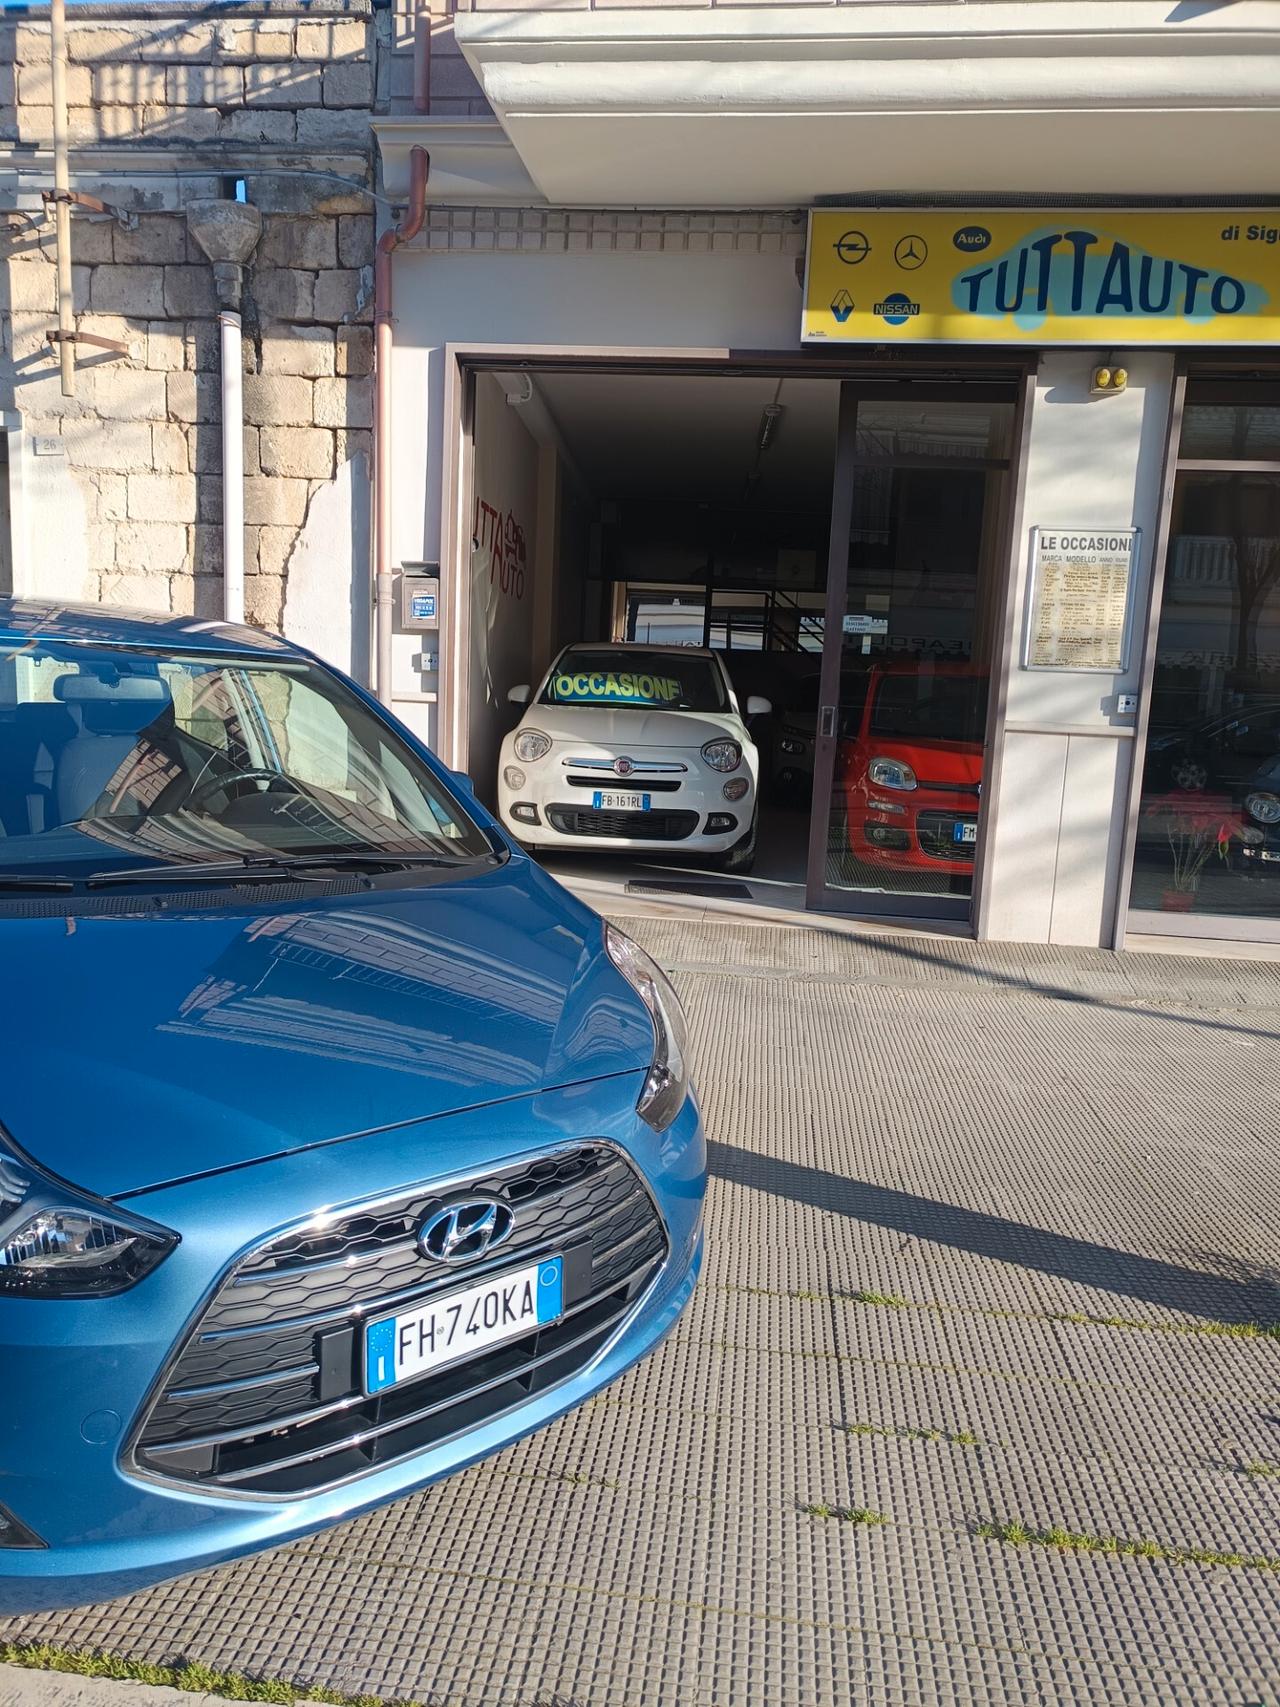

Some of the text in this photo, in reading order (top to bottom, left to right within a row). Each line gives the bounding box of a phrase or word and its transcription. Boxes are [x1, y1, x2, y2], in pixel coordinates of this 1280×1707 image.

[957, 233, 987, 243] Audi
[1221, 225, 1280, 244] di Sig
[961, 231, 1246, 314] TUTTAUTO
[875, 304, 918, 314] NISSAN
[43, 439, 56, 449] 26
[1041, 537, 1057, 550] LE
[1042, 554, 1062, 562] MARCA
[1066, 555, 1097, 564] MODELLO
[556, 673, 680, 700] OCCASIONE
